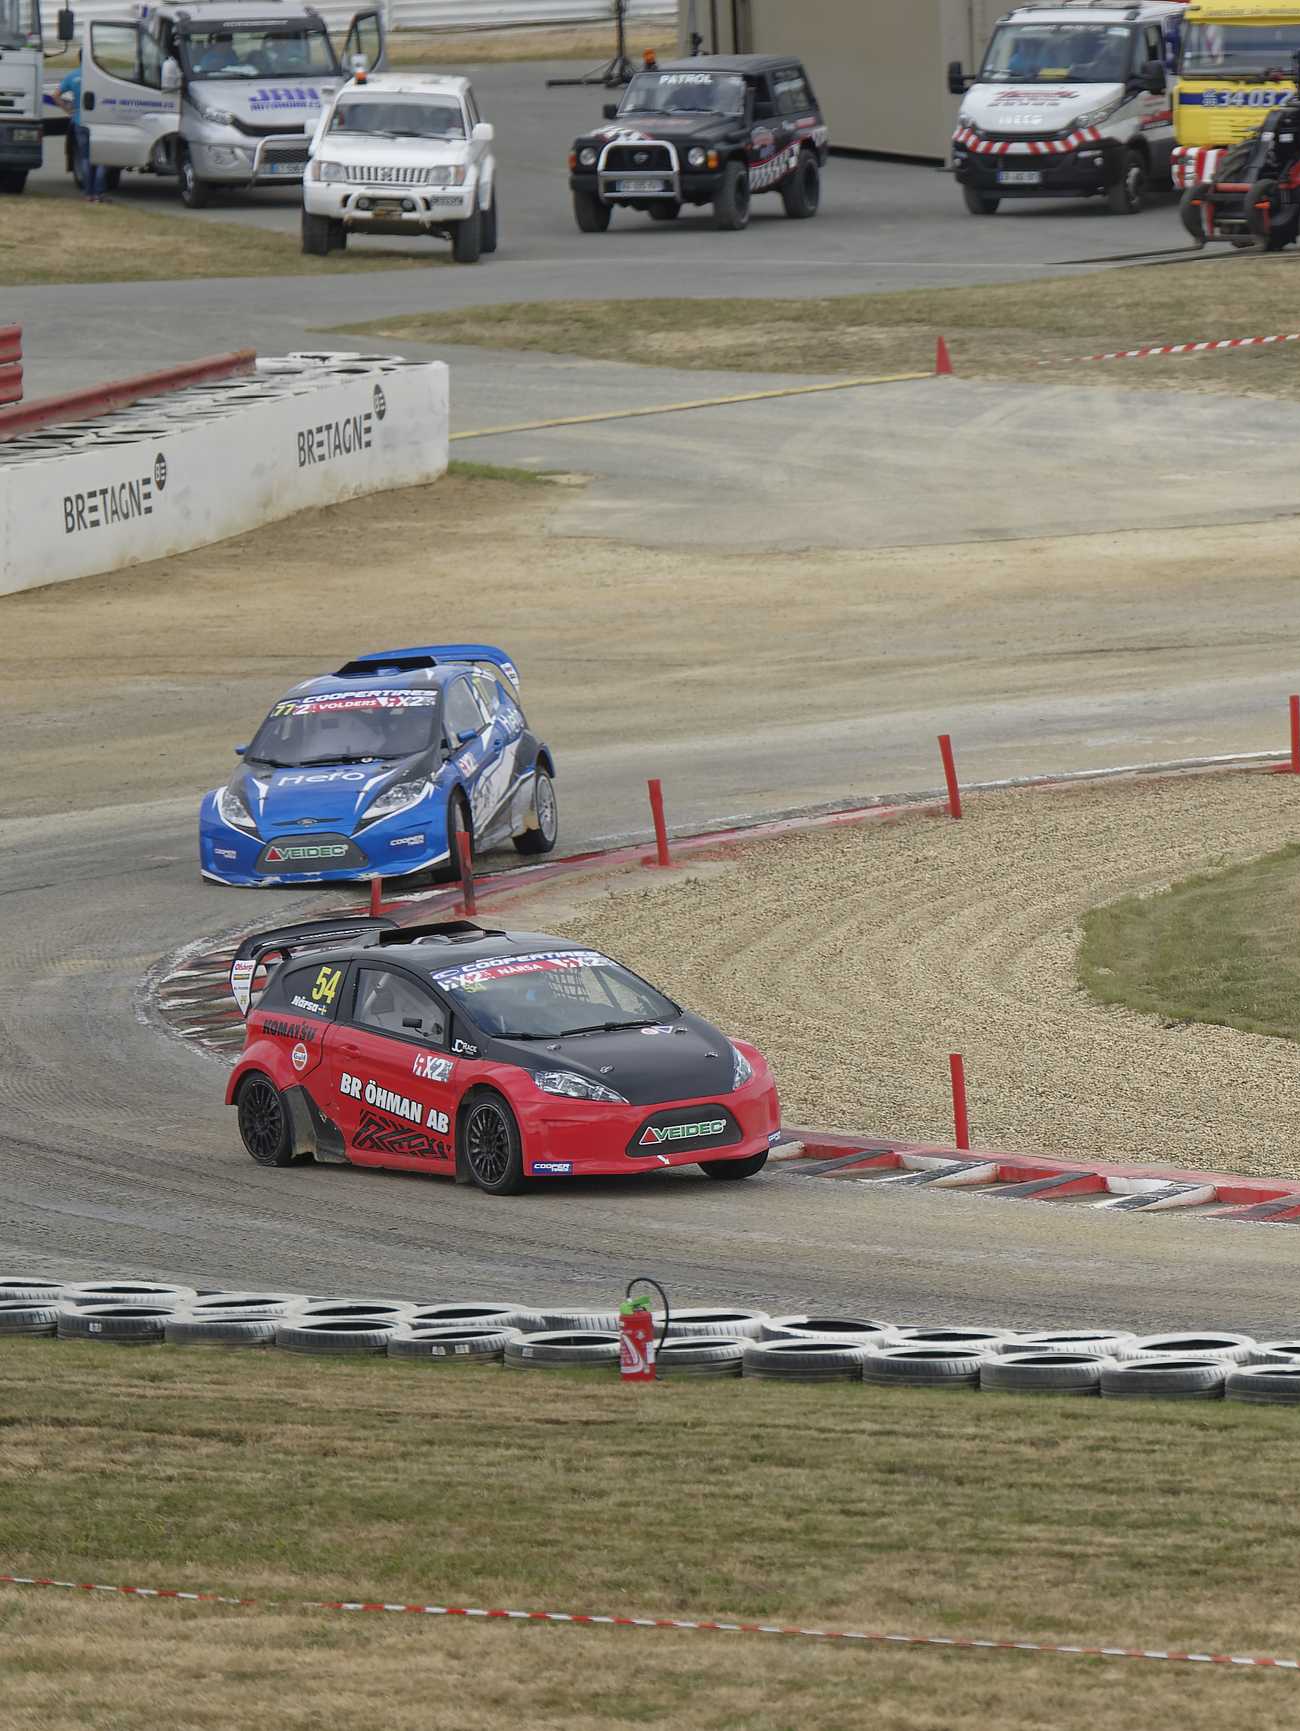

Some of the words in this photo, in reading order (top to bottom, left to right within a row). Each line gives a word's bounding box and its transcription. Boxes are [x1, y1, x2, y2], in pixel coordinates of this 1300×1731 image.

[658, 73, 713, 86] PATROL
[298, 412, 373, 468] BRETAGNE
[63, 476, 153, 534] BRETAGNE
[319, 699, 378, 711] VOLDERS
[279, 845, 349, 860] VEIDEC
[311, 966, 342, 1005] 54
[262, 1019, 317, 1041] KOMATSU
[340, 1072, 362, 1100] BR
[364, 1079, 423, 1125] ÖHMAN
[426, 1108, 450, 1134] AB
[653, 1119, 727, 1142] VEIDEC
[534, 1163, 570, 1172] COOPER
